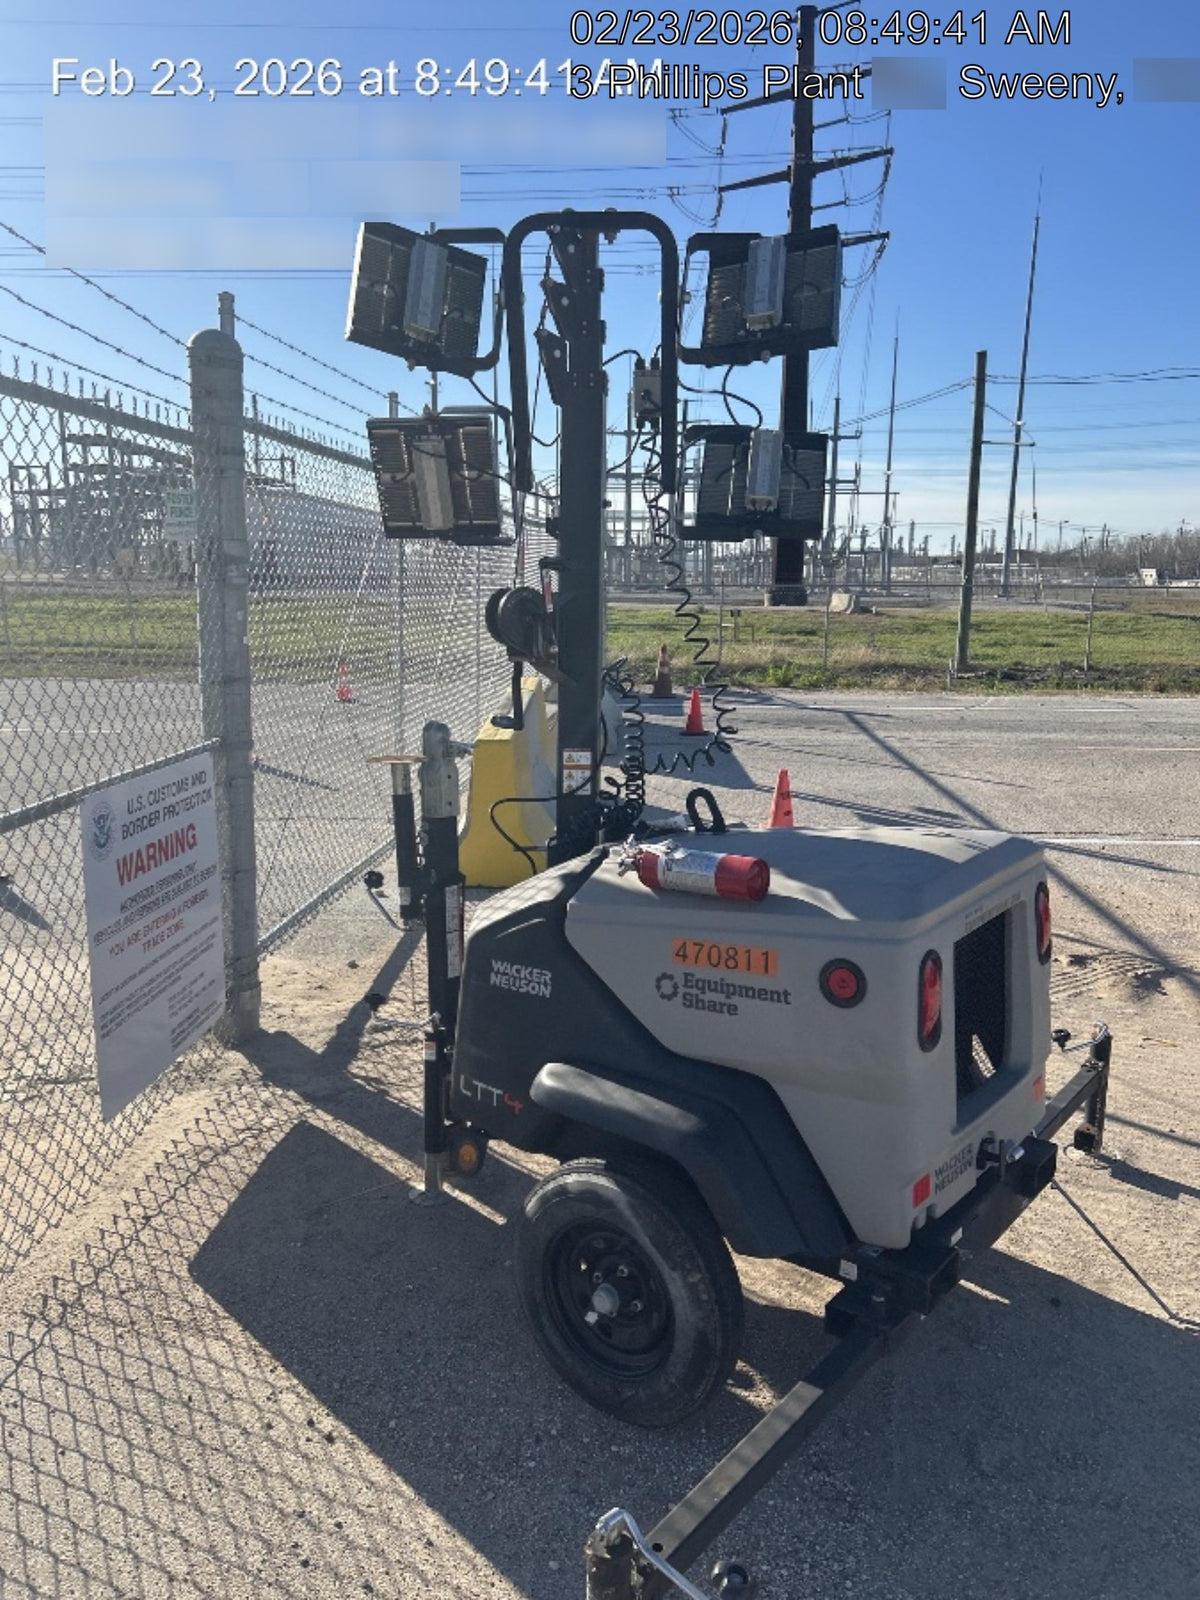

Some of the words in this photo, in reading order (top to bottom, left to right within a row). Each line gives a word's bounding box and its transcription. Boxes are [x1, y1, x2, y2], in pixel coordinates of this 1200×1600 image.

[127, 795, 147, 815] U.S.
[147, 776, 189, 807] CUSTOMS
[191, 770, 207, 788] AND
[121, 809, 161, 840] BORDER
[115, 822, 198, 887] WARNING
[490, 959, 552, 984] WACKER
[674, 941, 770, 975] 470811
[489, 971, 552, 998] NEUSON
[682, 972, 792, 1005] Equipment
[682, 991, 739, 1017] Share
